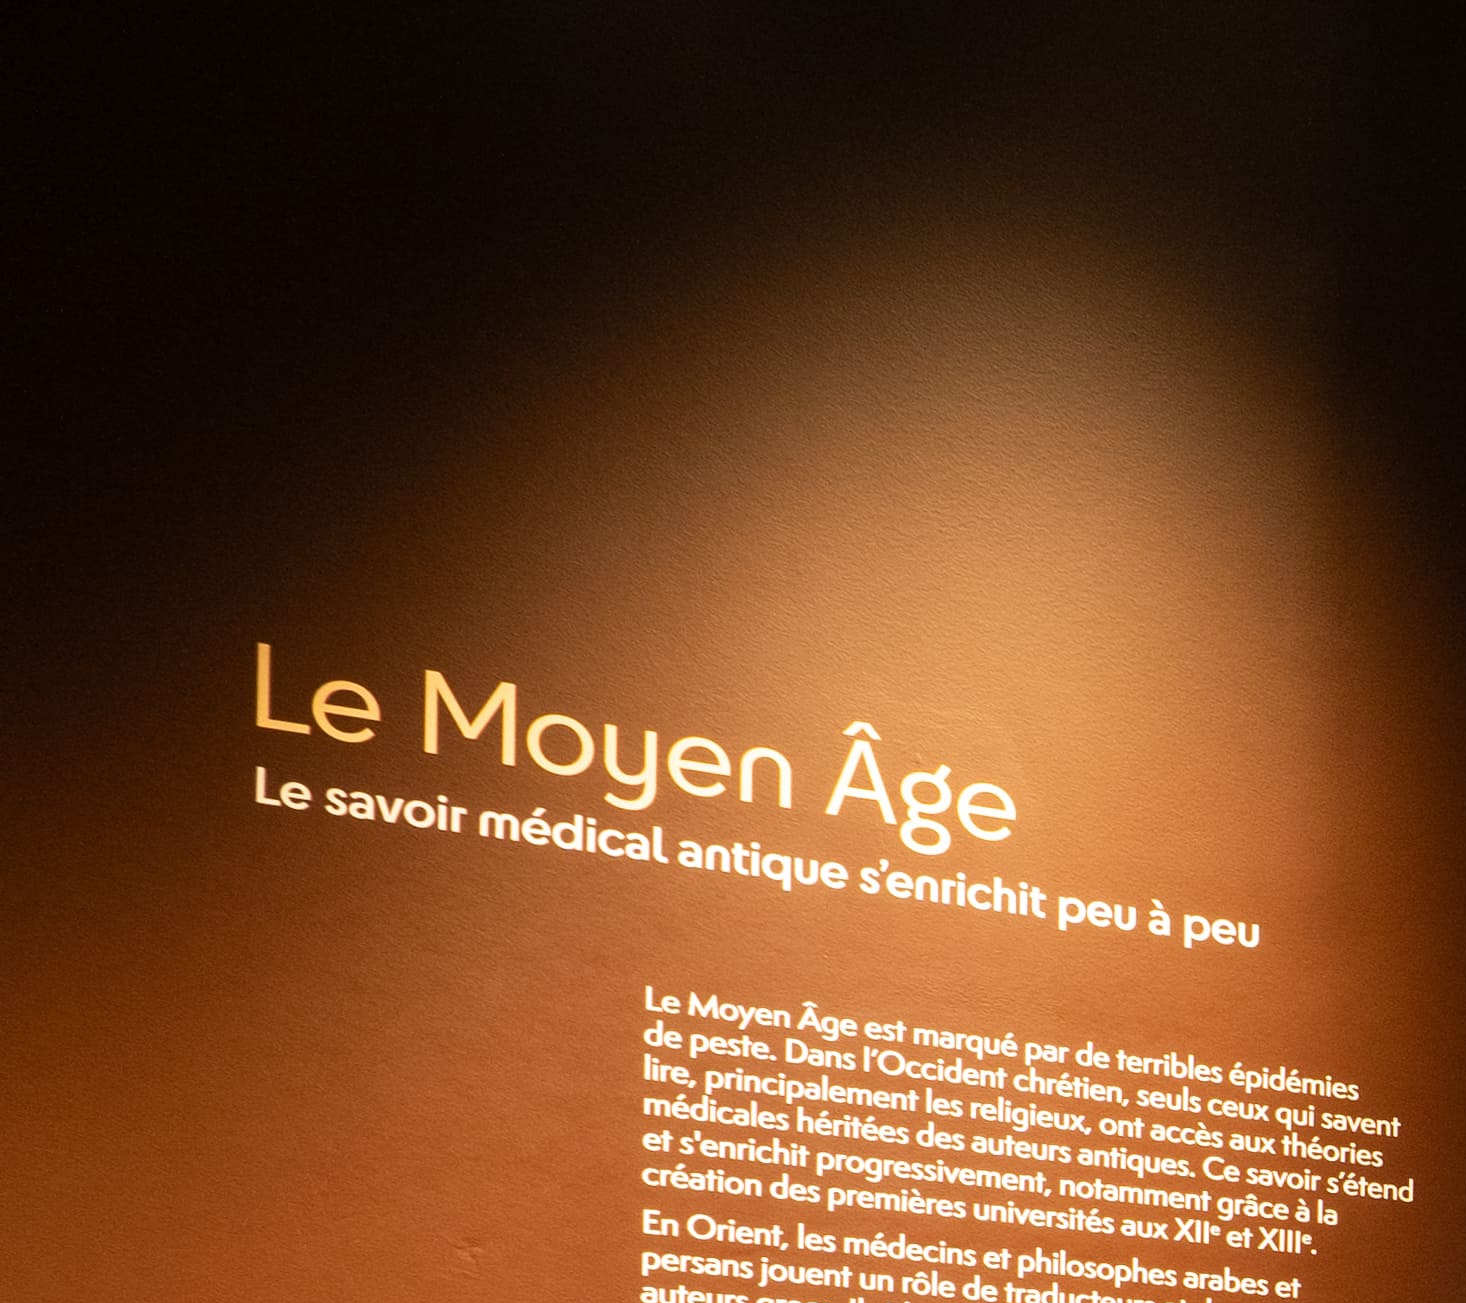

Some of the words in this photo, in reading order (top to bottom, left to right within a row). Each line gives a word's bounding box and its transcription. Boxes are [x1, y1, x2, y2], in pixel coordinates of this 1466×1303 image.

[256, 642, 381, 745] Le
[423, 668, 794, 811] Moyen
[824, 720, 1018, 856] Âge
[256, 766, 311, 810] Le
[325, 788, 467, 832] savoir
[479, 808, 669, 864] médical
[678, 841, 848, 891] antique
[859, 859, 1047, 918] s'enrichit
[1058, 896, 1136, 931] peu
[1149, 899, 1170, 936] à
[1184, 914, 1260, 948] peu
[643, 1019, 683, 1049] de
[689, 1033, 777, 1061] peste.
[785, 1037, 856, 1071] Dans
[863, 1045, 1008, 1089] l'Occident
[1012, 1066, 1129, 1107] chrétien,
[1135, 1085, 1202, 1113] seuls
[1207, 1098, 1269, 1122] ceux
[1275, 1104, 1315, 1131] qui
[1320, 1112, 1402, 1138] savent
[645, 984, 681, 1014] Le
[687, 991, 791, 1030] Moyen
[796, 1000, 858, 1042] Âge
[863, 1020, 907, 1043] est
[912, 1027, 1018, 1060] marqué
[1024, 1041, 1070, 1066] par
[1074, 1040, 1111, 1069] de
[1115, 1048, 1223, 1084] terribles
[1228, 1061, 1359, 1101] épidémies
[643, 1052, 697, 1089] lire,
[704, 1067, 920, 1112] principalement
[925, 1086, 964, 1118] les
[969, 1095, 1092, 1136] religieux,
[1098, 1116, 1145, 1139] ont
[1149, 1121, 1224, 1149] accès
[1228, 1133, 1276, 1155] aux
[1280, 1131, 1383, 1168] théories
[643, 1093, 790, 1131] médicales
[796, 1105, 910, 1145] héritées
[915, 1120, 965, 1151] des
[970, 1134, 1072, 1164] auteurs
[1076, 1146, 1196, 1179] antiques.
[1202, 1155, 1241, 1183] Ce
[1245, 1167, 1322, 1191] savoir
[1326, 1171, 1414, 1203] s'étend
[641, 1129, 674, 1153] et
[678, 1129, 810, 1167] s'enrichit
[816, 1151, 1052, 1197] progressivement,
[1059, 1177, 1212, 1212] notamment
[1216, 1192, 1290, 1222] grâce
[1294, 1197, 1310, 1223] à
[1317, 1198, 1338, 1226] la
[641, 1162, 762, 1197] création
[769, 1172, 821, 1203] des
[827, 1186, 967, 1219] premières
[973, 1200, 1115, 1234] universités
[1120, 1218, 1169, 1240] aux
[1173, 1216, 1221, 1245] XIIe
[1225, 1227, 1254, 1249] et
[1257, 1226, 1317, 1255] XIIIe.
